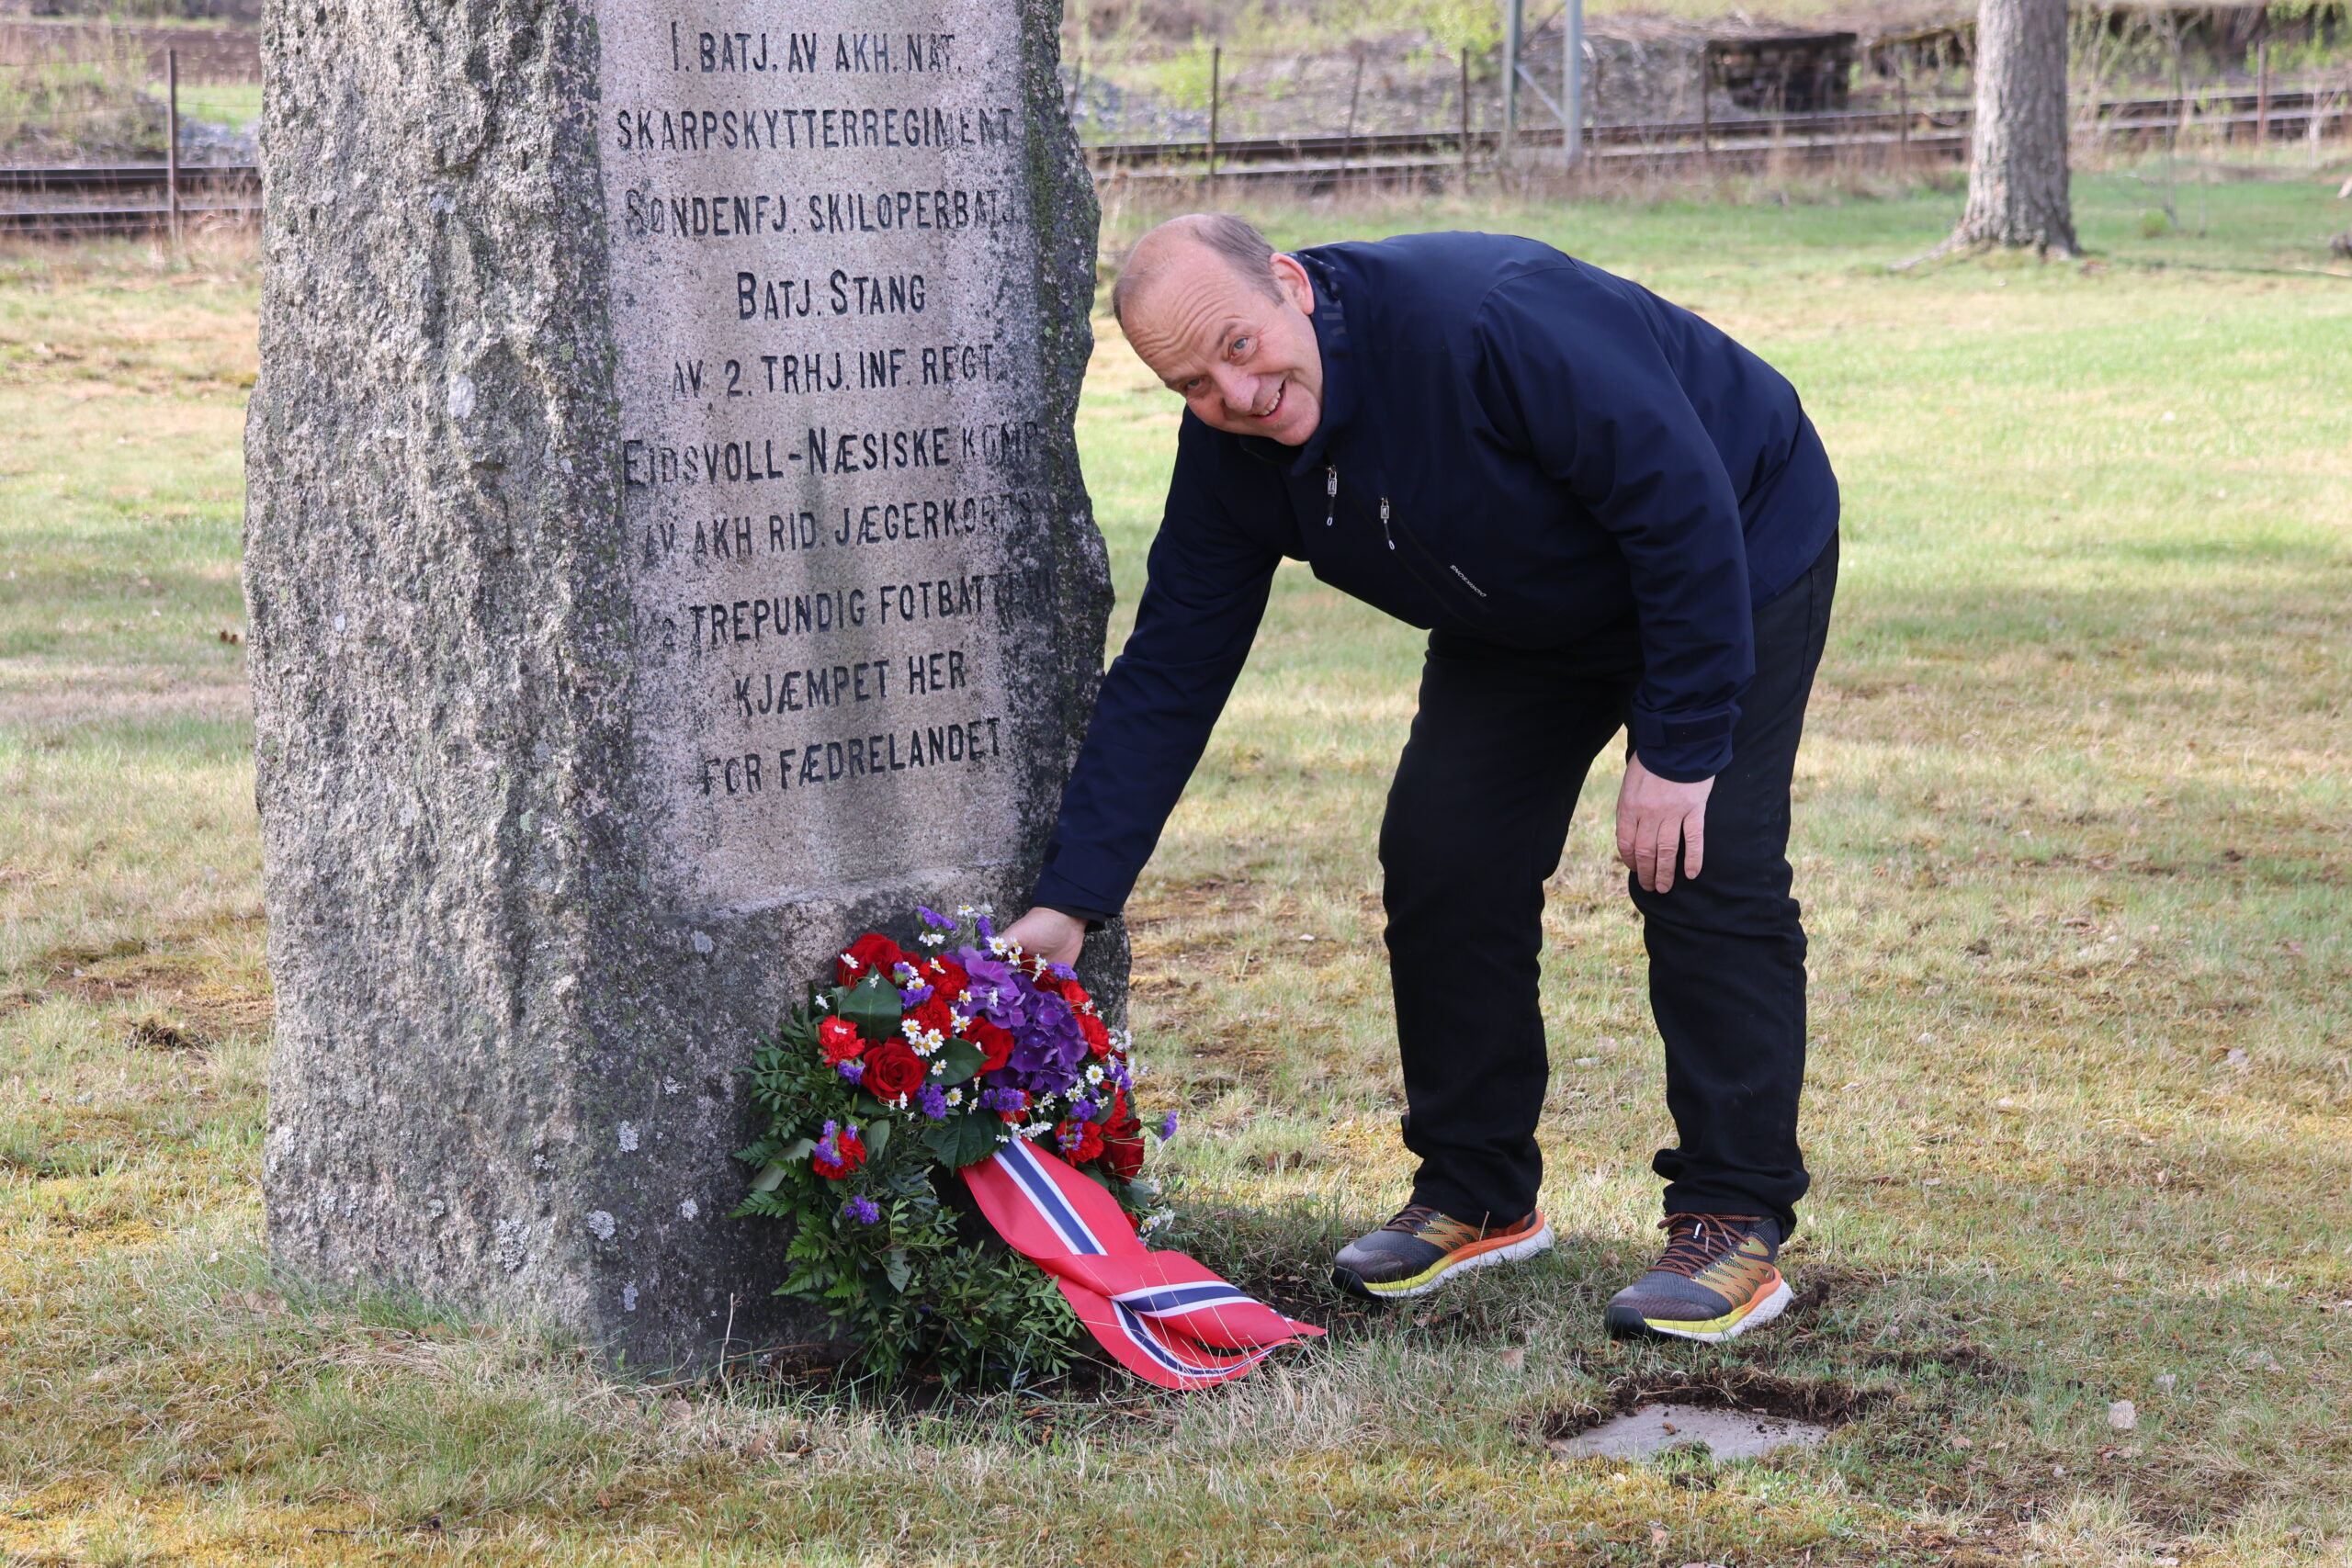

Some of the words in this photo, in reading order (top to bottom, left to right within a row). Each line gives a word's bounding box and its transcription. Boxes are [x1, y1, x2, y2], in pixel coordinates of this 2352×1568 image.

[699, 32, 778, 74] BATJ.
[788, 31, 818, 73] AV
[835, 33, 899, 73] AKH.
[907, 34, 963, 73] NAT.
[616, 107, 1012, 152] SKARPSKYTTERREGIMENT
[625, 188, 798, 238] SØNDENFJ.
[831, 268, 926, 316] STANG
[672, 360, 704, 401] AV
[761, 354, 851, 395] TRHJ.
[859, 349, 911, 389] INF.
[690, 588, 865, 647] TREPUNDIG
[736, 659, 889, 717] KJÆMPET
[908, 650, 966, 695] HER
[703, 753, 763, 795] FOR
[780, 717, 1001, 790] FÆDRELANDET
